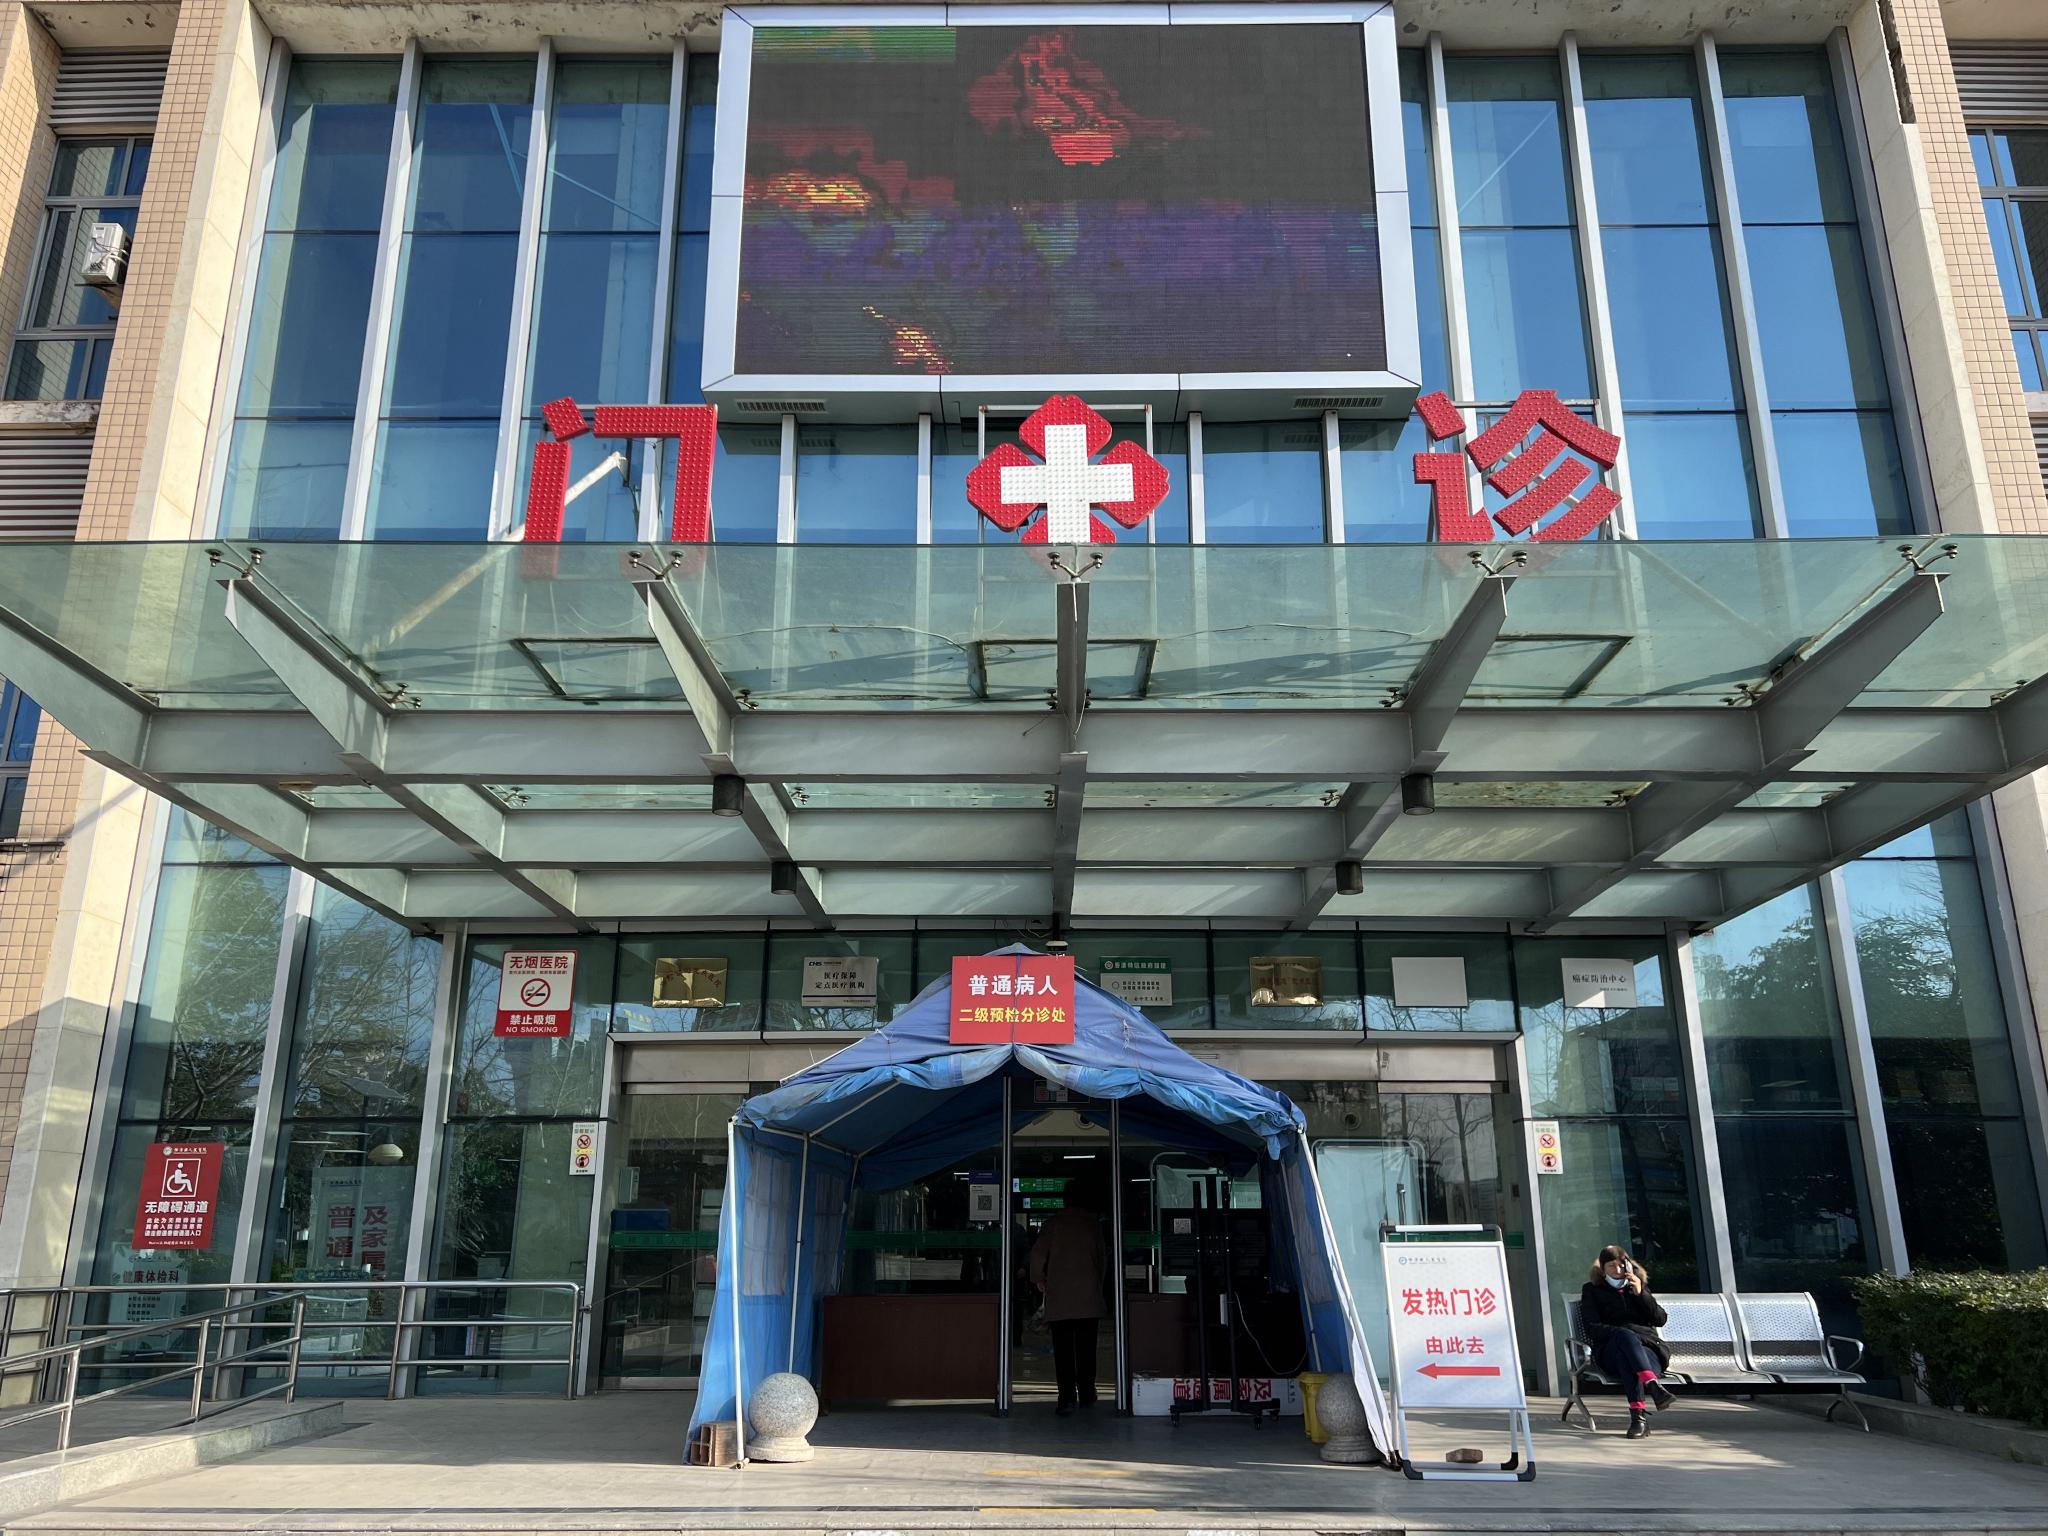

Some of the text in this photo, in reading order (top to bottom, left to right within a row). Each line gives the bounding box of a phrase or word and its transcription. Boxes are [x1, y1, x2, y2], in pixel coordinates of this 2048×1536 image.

[524, 390, 1623, 542] 门 诊
[509, 956, 569, 969] 无烟医院
[823, 971, 857, 980] 医疗保障
[815, 981, 865, 989] 定点医疗机构
[968, 975, 1058, 996] 普通病人
[509, 1014, 557, 1025] 禁止吸烟
[959, 1007, 1066, 1023] 二级预检分诊处
[145, 1201, 208, 1213] 无障碍通道
[327, 1206, 356, 1258] 普通
[1402, 1288, 1496, 1316] 发热门诊
[1425, 1336, 1485, 1354] 由此去
